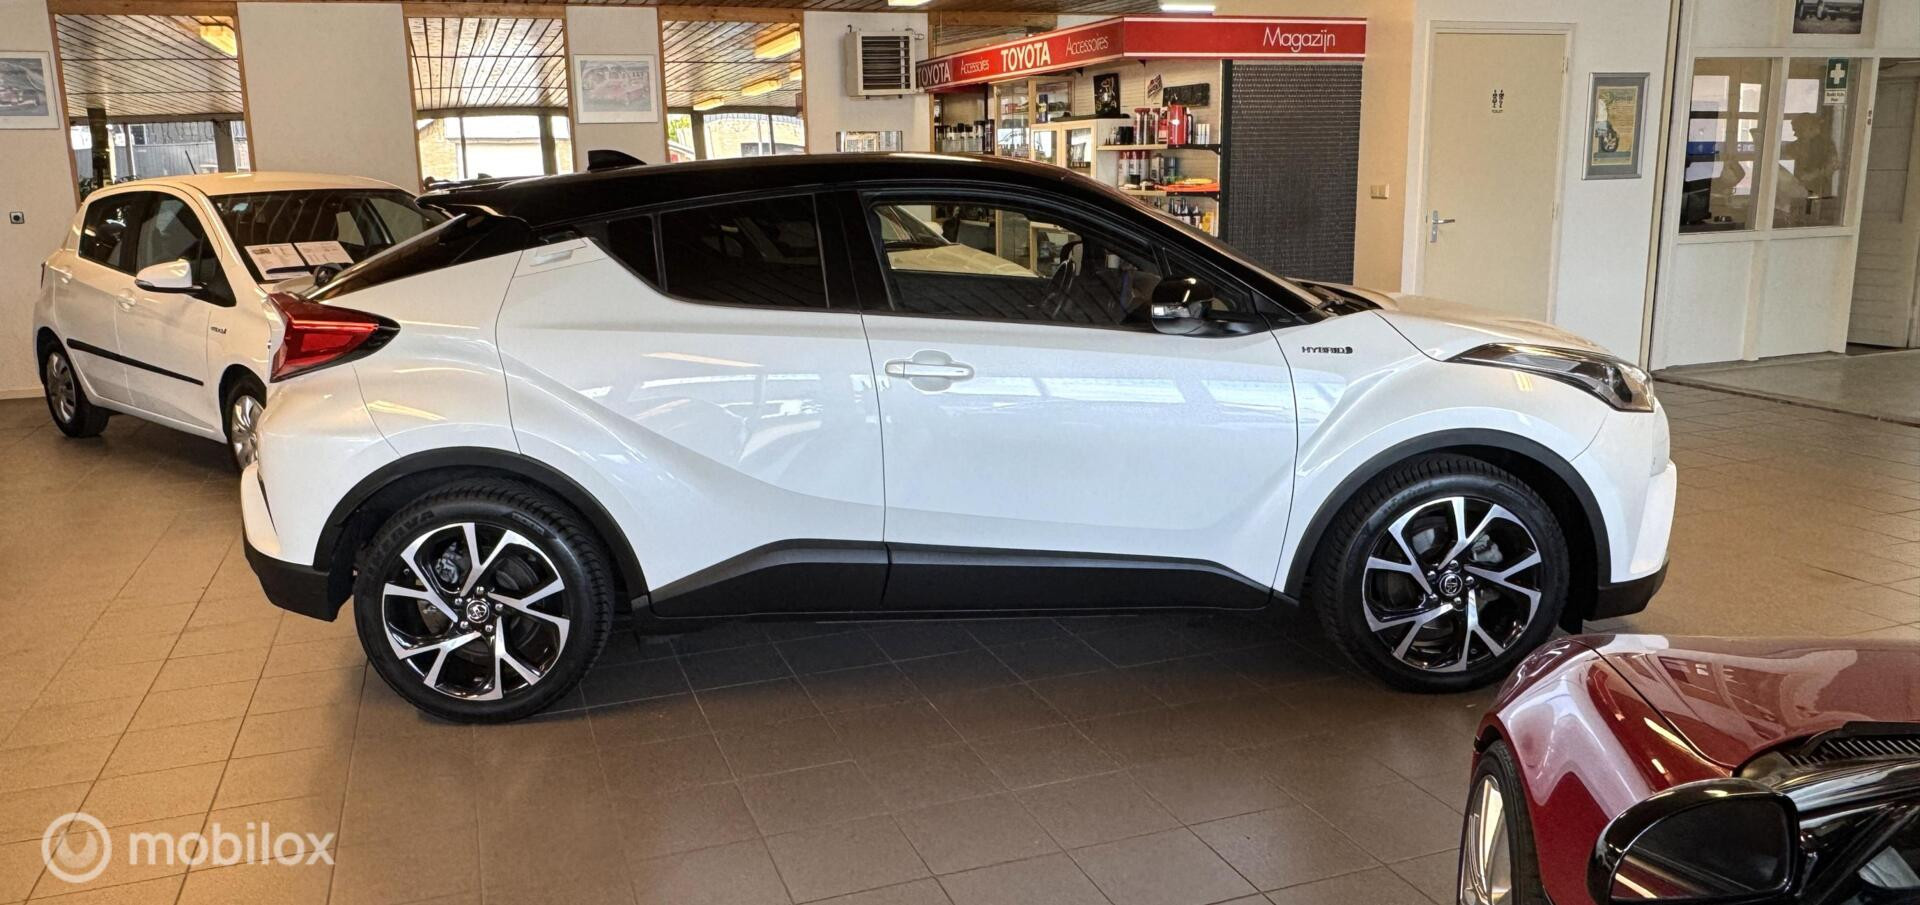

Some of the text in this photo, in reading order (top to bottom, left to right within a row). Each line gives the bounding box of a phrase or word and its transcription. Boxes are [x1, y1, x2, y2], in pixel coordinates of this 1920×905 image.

[917, 62, 952, 86] TOYOTA
[1000, 41, 1052, 73] TOYOTA
[1065, 33, 1110, 57] Accessoires
[1263, 26, 1336, 53] Magazijn
